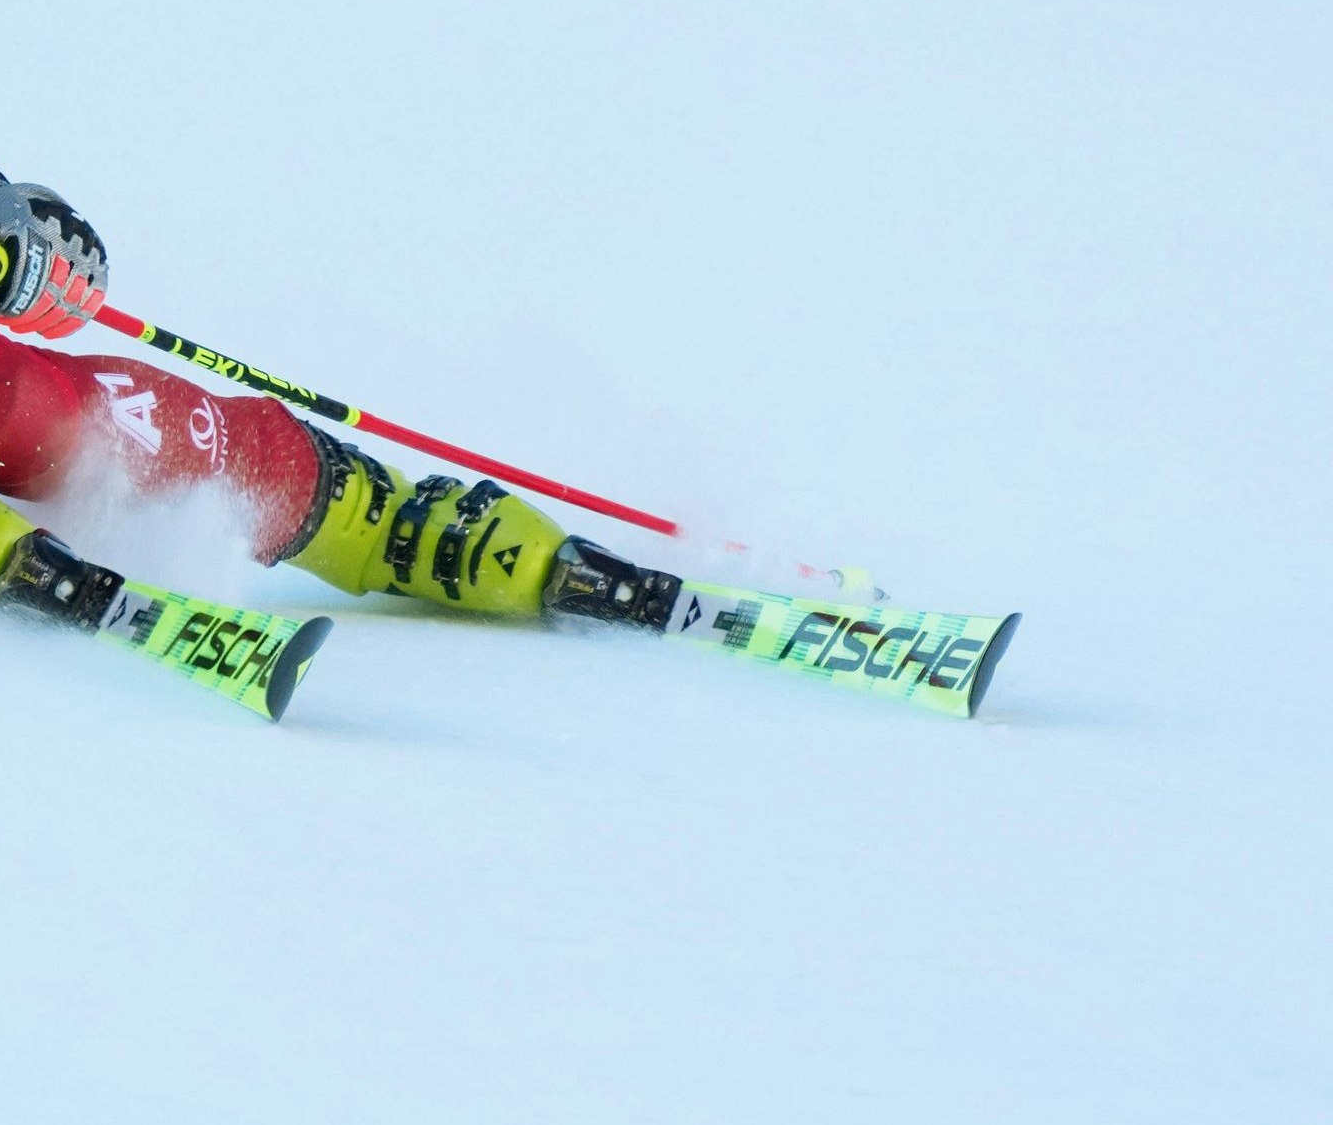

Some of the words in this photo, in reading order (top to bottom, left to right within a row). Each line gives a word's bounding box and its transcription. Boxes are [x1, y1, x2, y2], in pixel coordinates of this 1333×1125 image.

[11, 244, 44, 315] reusch
[170, 337, 244, 382] LEKI
[162, 611, 282, 689] FISCH
